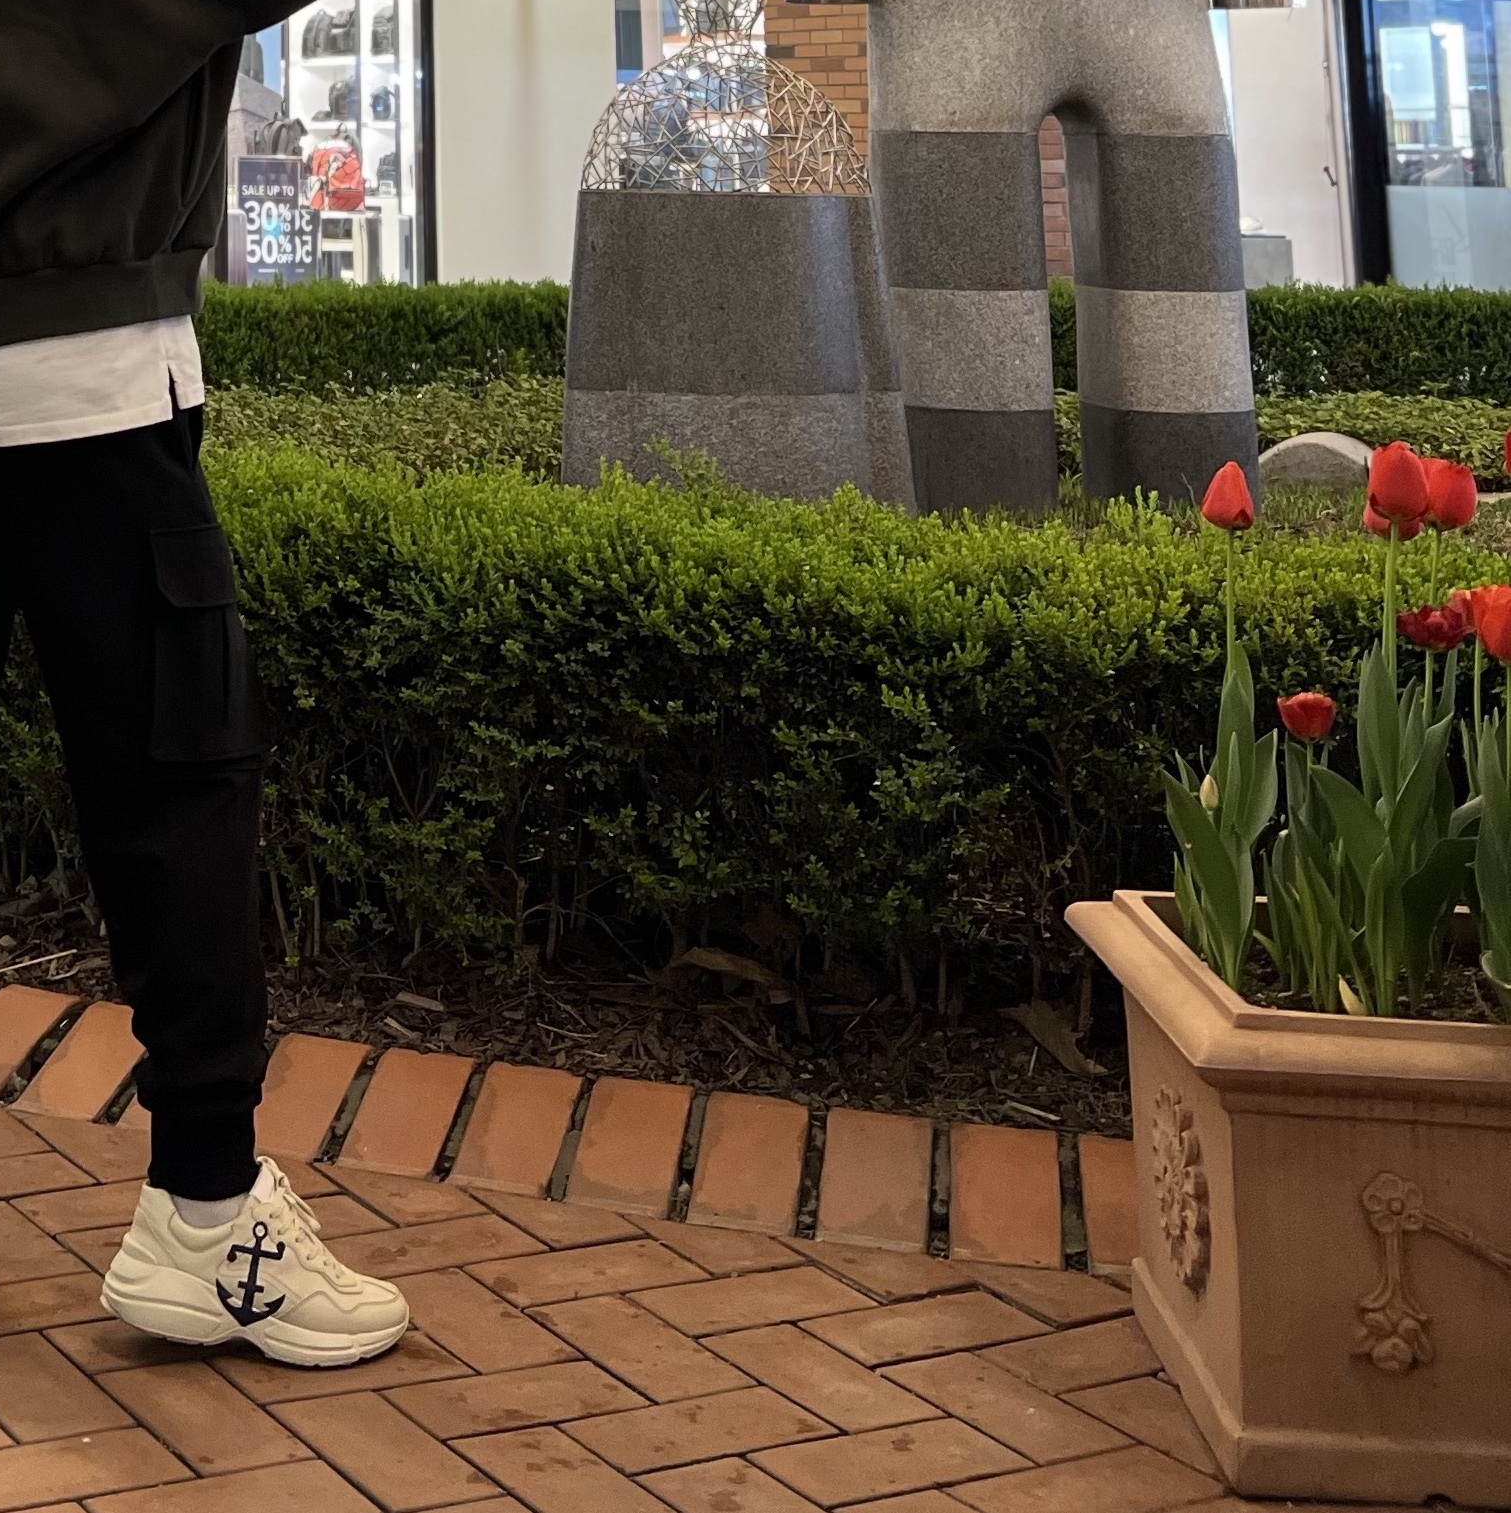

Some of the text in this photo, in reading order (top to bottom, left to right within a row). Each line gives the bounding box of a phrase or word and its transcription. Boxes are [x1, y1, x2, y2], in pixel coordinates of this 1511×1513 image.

[241, 184, 295, 196] SALE UP TO
[243, 200, 292, 231] 30%
[280, 222, 291, 232] TO
[246, 234, 292, 264] 50%
[277, 253, 294, 264] OFF
